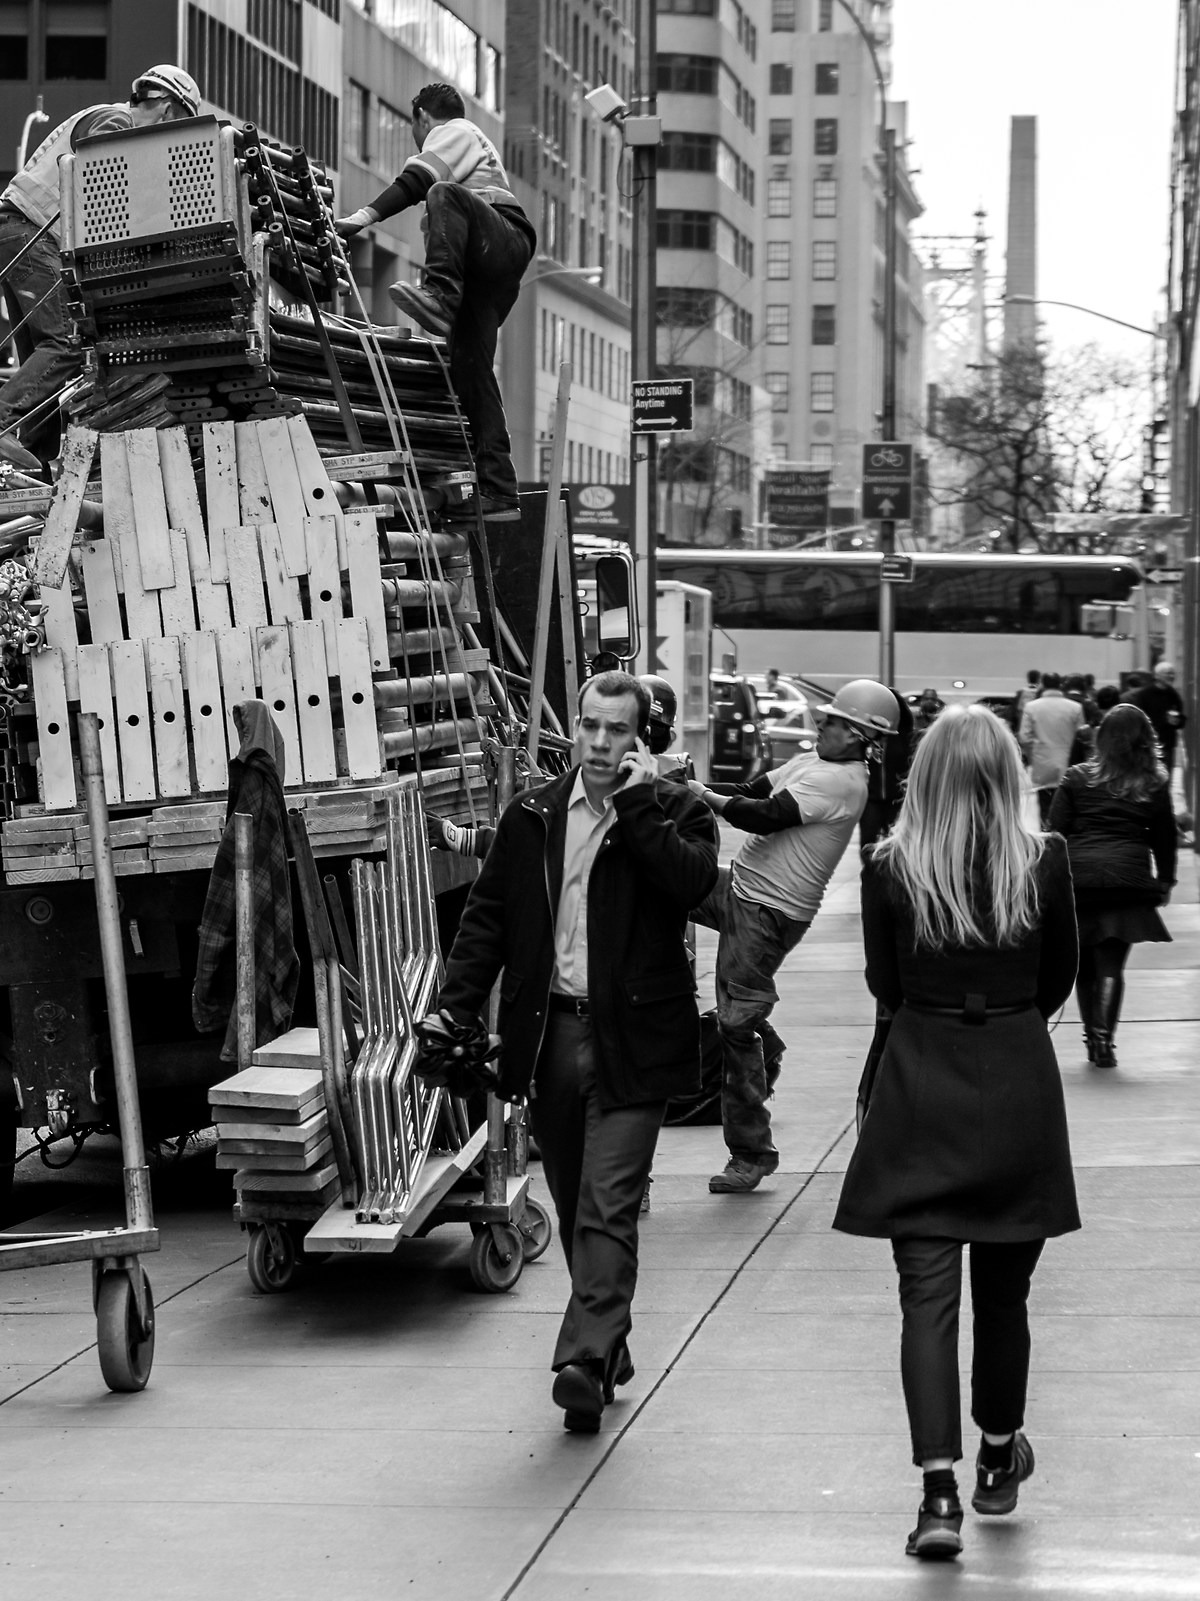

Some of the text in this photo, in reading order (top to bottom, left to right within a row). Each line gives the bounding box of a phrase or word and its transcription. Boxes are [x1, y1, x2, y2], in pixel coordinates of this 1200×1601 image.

[635, 386, 683, 397] NO STANDING
[635, 399, 665, 410] Anytime
[12, 491, 26, 499] SYP
[873, 487, 900, 496] Bridge
